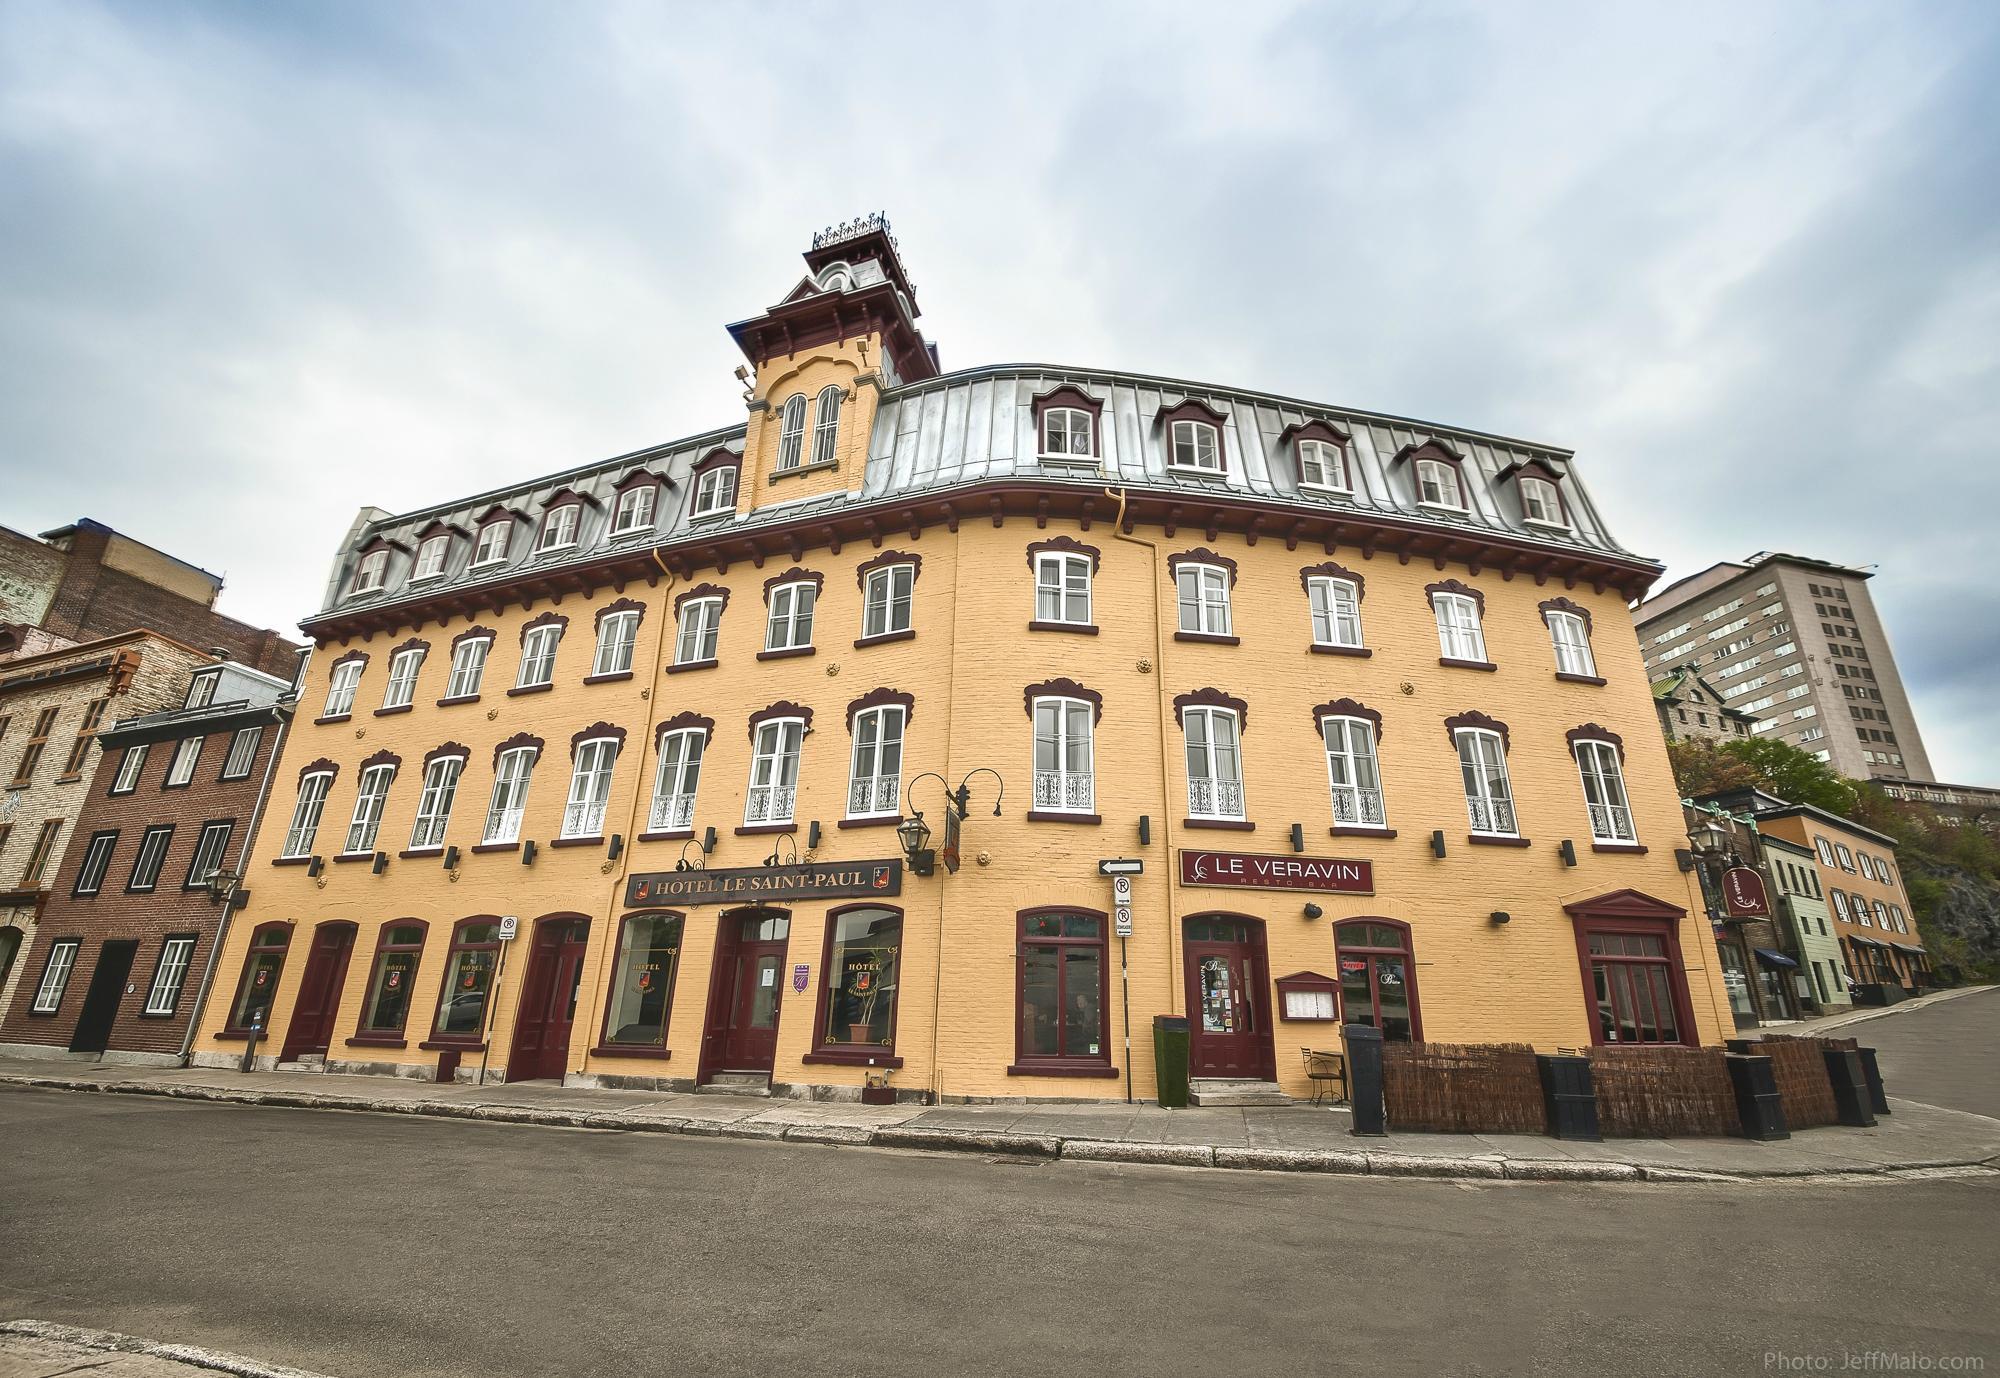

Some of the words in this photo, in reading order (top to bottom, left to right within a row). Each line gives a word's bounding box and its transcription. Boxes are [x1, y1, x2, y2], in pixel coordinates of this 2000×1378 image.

[1215, 858, 1244, 874] LE
[1254, 860, 1360, 880] VERAVIN
[655, 878, 718, 895] HÔTEL
[723, 877, 746, 892] LE
[750, 871, 866, 890] SAINT-PAUL
[1240, 878, 1293, 886] RESTO
